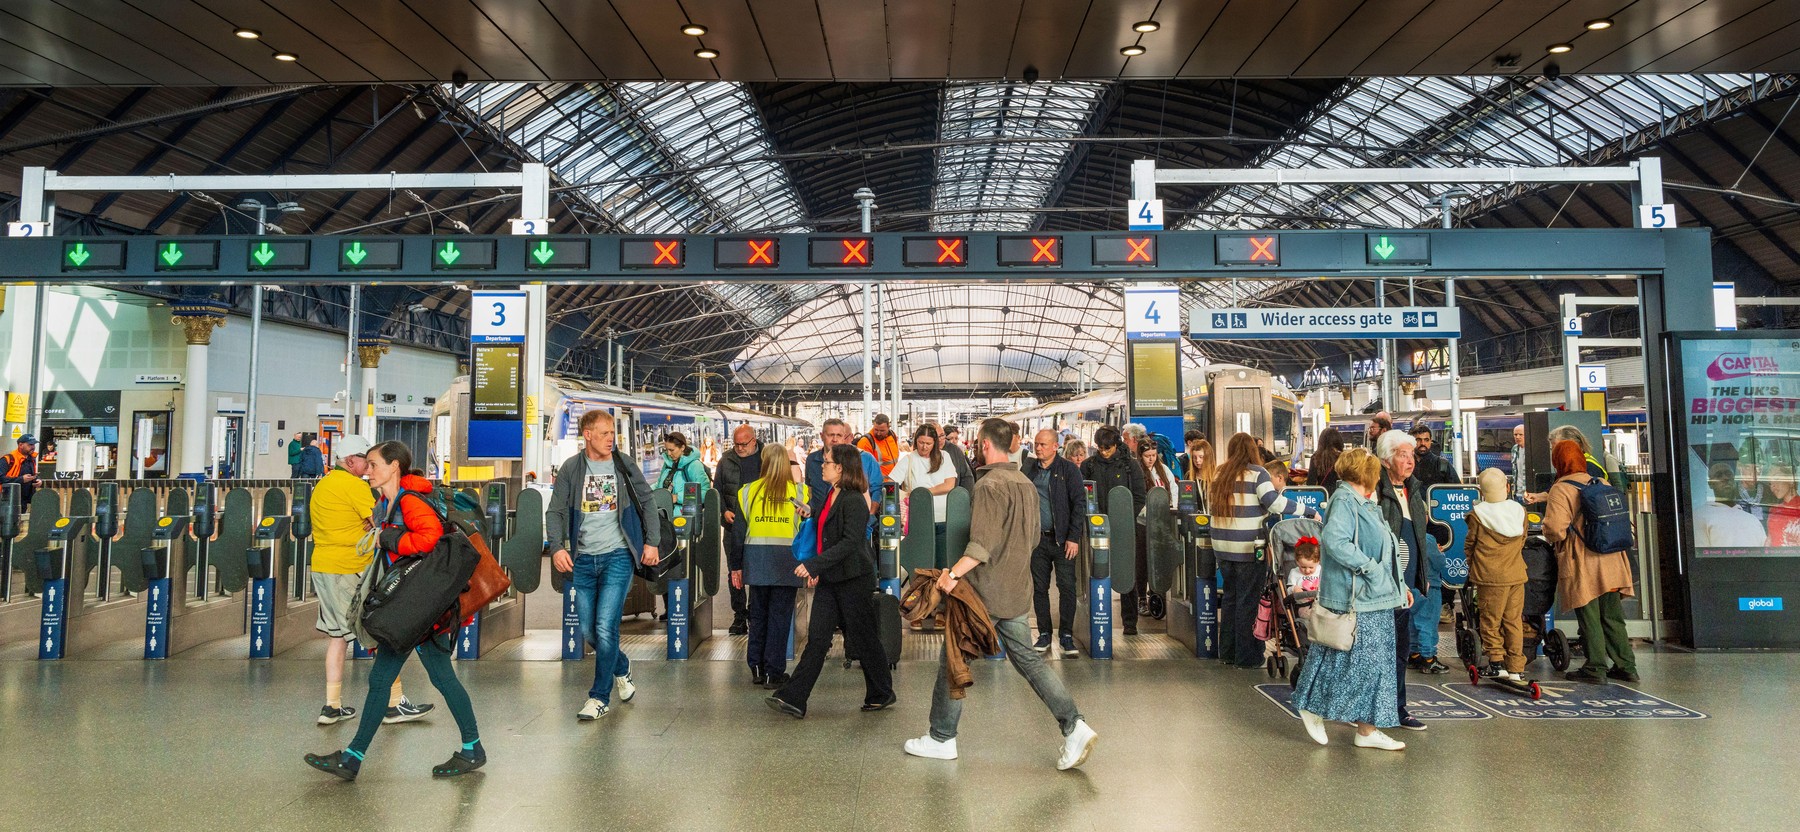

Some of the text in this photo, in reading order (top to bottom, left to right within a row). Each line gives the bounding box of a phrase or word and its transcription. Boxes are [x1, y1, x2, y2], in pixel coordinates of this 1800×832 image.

[1139, 202, 1153, 223] 4
[1652, 206, 1665, 228] 5
[491, 302, 506, 326] 3
[1145, 300, 1161, 325] 4
[1261, 312, 1392, 328] Wider access gate
[1570, 318, 1576, 330] 6
[1722, 357, 1779, 370] CAPITAL
[1589, 370, 1596, 383] 6
[1711, 387, 1780, 396] THE UK'S
[1691, 398, 1798, 413] BIGGEST
[1691, 415, 1718, 424] HIP
[1722, 415, 1754, 424] HOP
[1759, 415, 1768, 424] &
[1296, 495, 1316, 504] Wide
[1450, 512, 1466, 521] gat
[1749, 599, 1774, 609] global
[1582, 699, 1661, 707] gate
